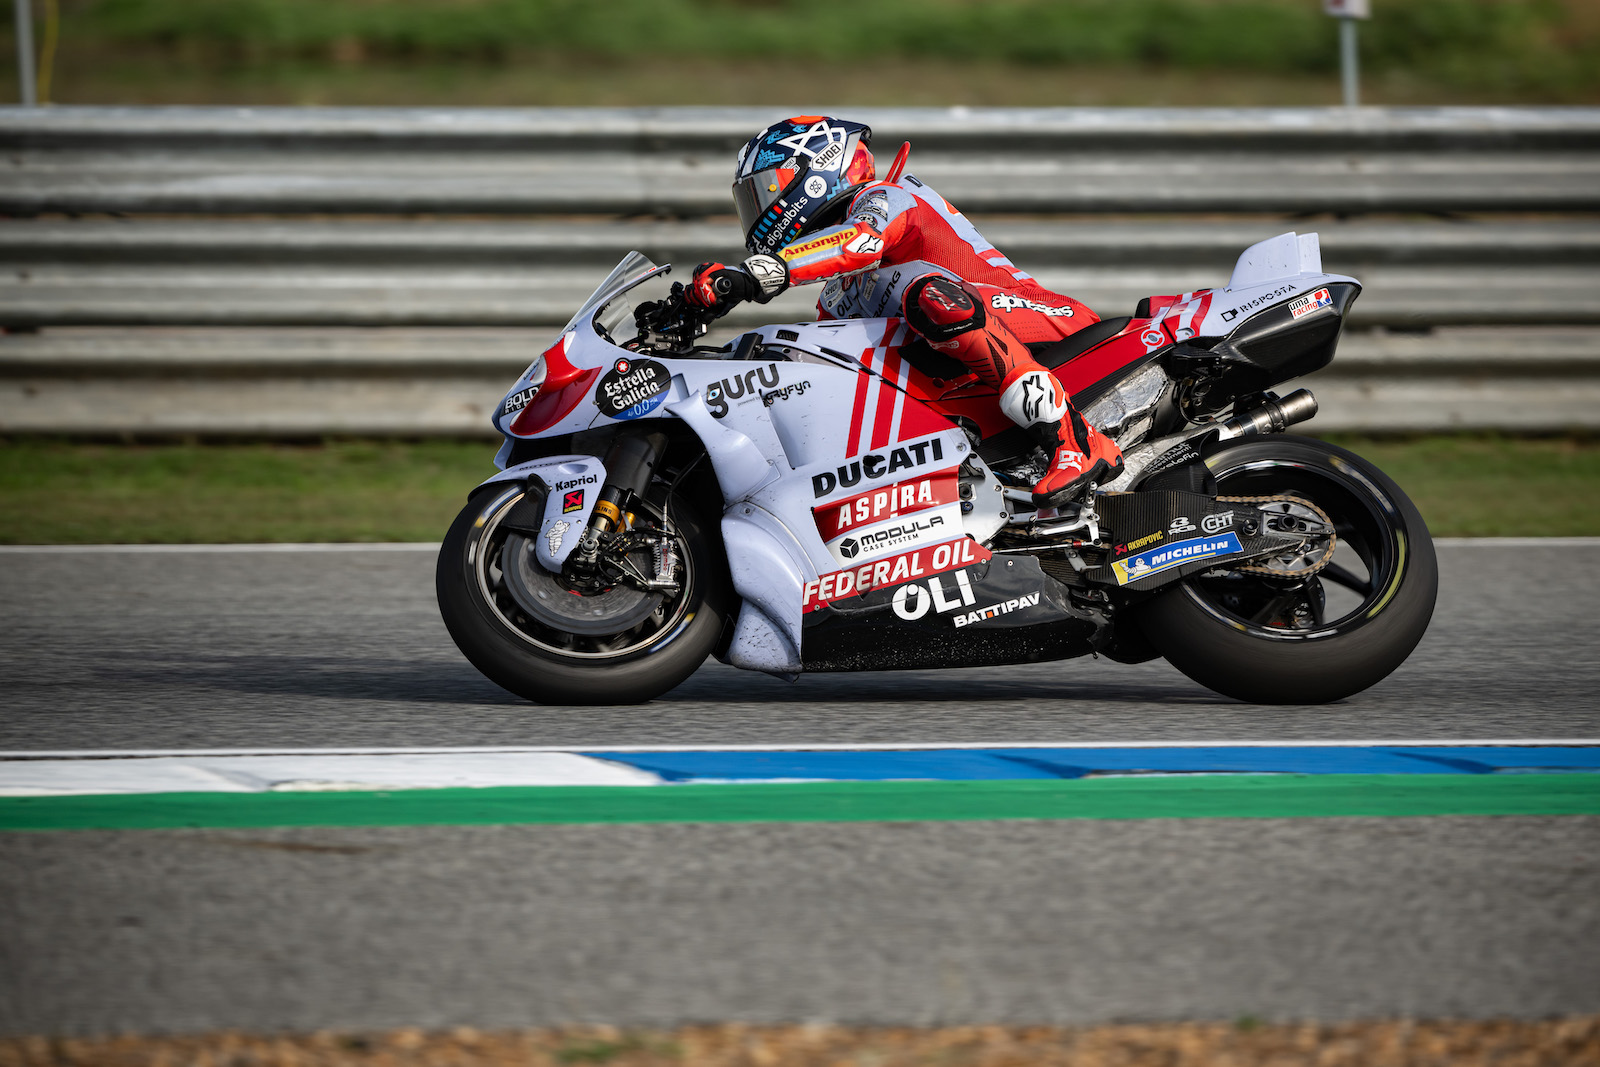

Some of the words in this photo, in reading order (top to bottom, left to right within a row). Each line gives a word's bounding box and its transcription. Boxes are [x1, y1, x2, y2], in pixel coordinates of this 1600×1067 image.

[815, 144, 842, 168] SHOEI
[766, 195, 809, 247] digitalbits
[1239, 284, 1297, 313] RISPOSTA
[1289, 296, 1310, 311] uma
[1292, 301, 1319, 318] racing
[604, 367, 656, 398] Estrella
[611, 381, 661, 410] Galicia
[505, 386, 539, 409] BOLD
[811, 437, 944, 499] DUCATI
[555, 474, 598, 493] Kapriol
[860, 515, 945, 547] MODULA
[863, 543, 885, 553] CASE
[888, 533, 920, 546] SYSTEM
[1151, 540, 1229, 566] MICHELIN
[803, 551, 925, 607] FEDERAL
[931, 538, 975, 570] OIL
[891, 569, 977, 621] OLI
